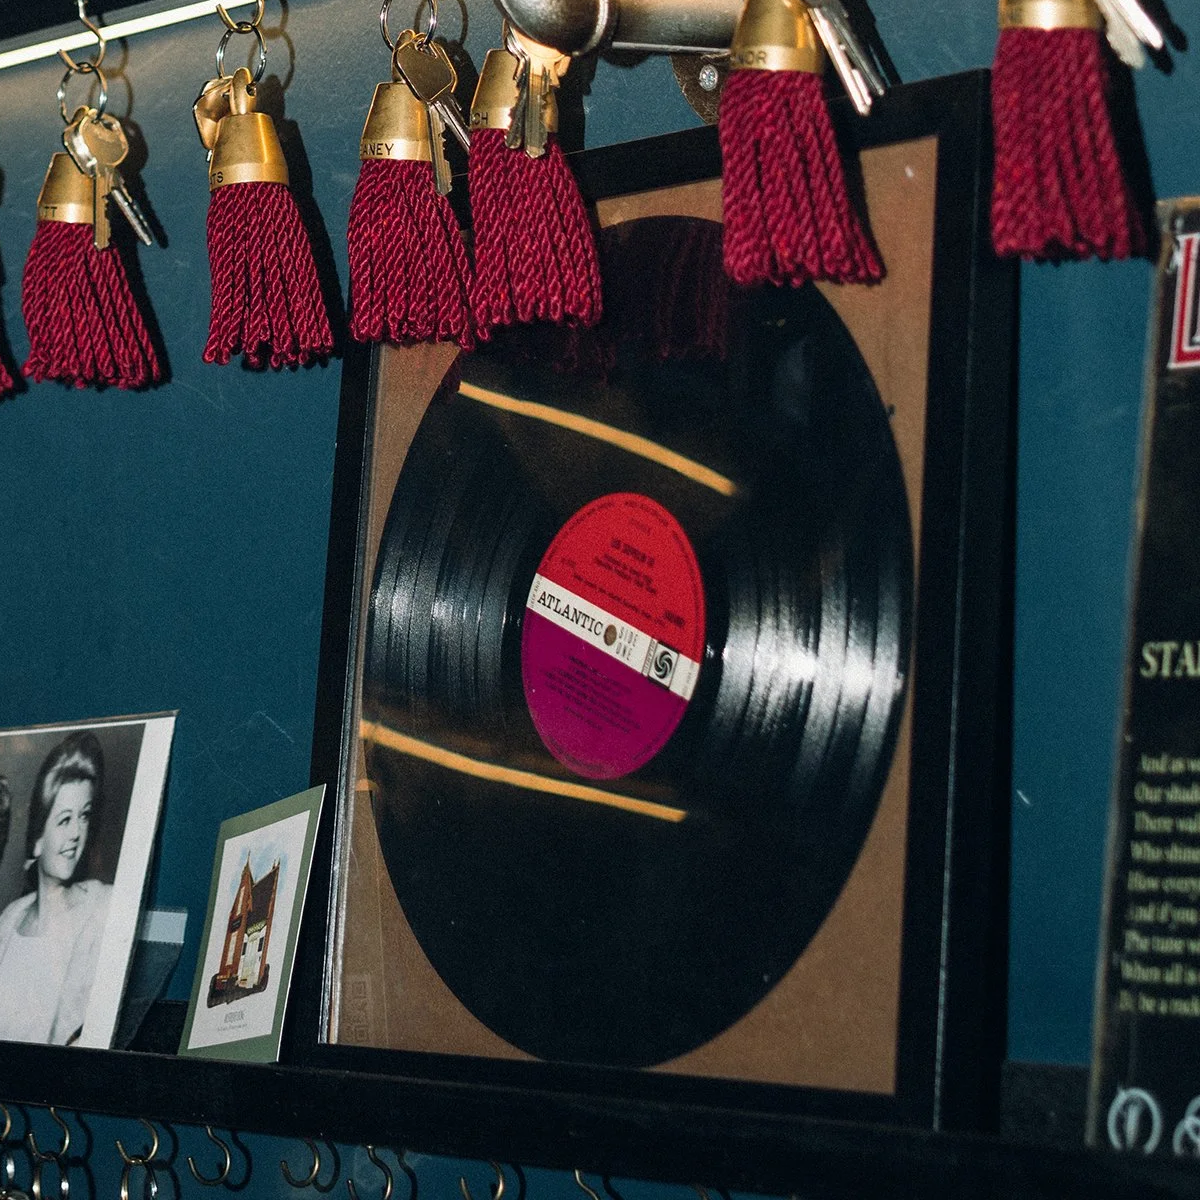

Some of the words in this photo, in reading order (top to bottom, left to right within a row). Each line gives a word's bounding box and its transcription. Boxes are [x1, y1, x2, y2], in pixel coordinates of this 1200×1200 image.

[361, 142, 395, 156] ANEY
[537, 589, 604, 636] ATLANTIC
[617, 625, 639, 648] SIDE
[615, 641, 633, 662] ONE
[1140, 640, 1200, 678] STA
